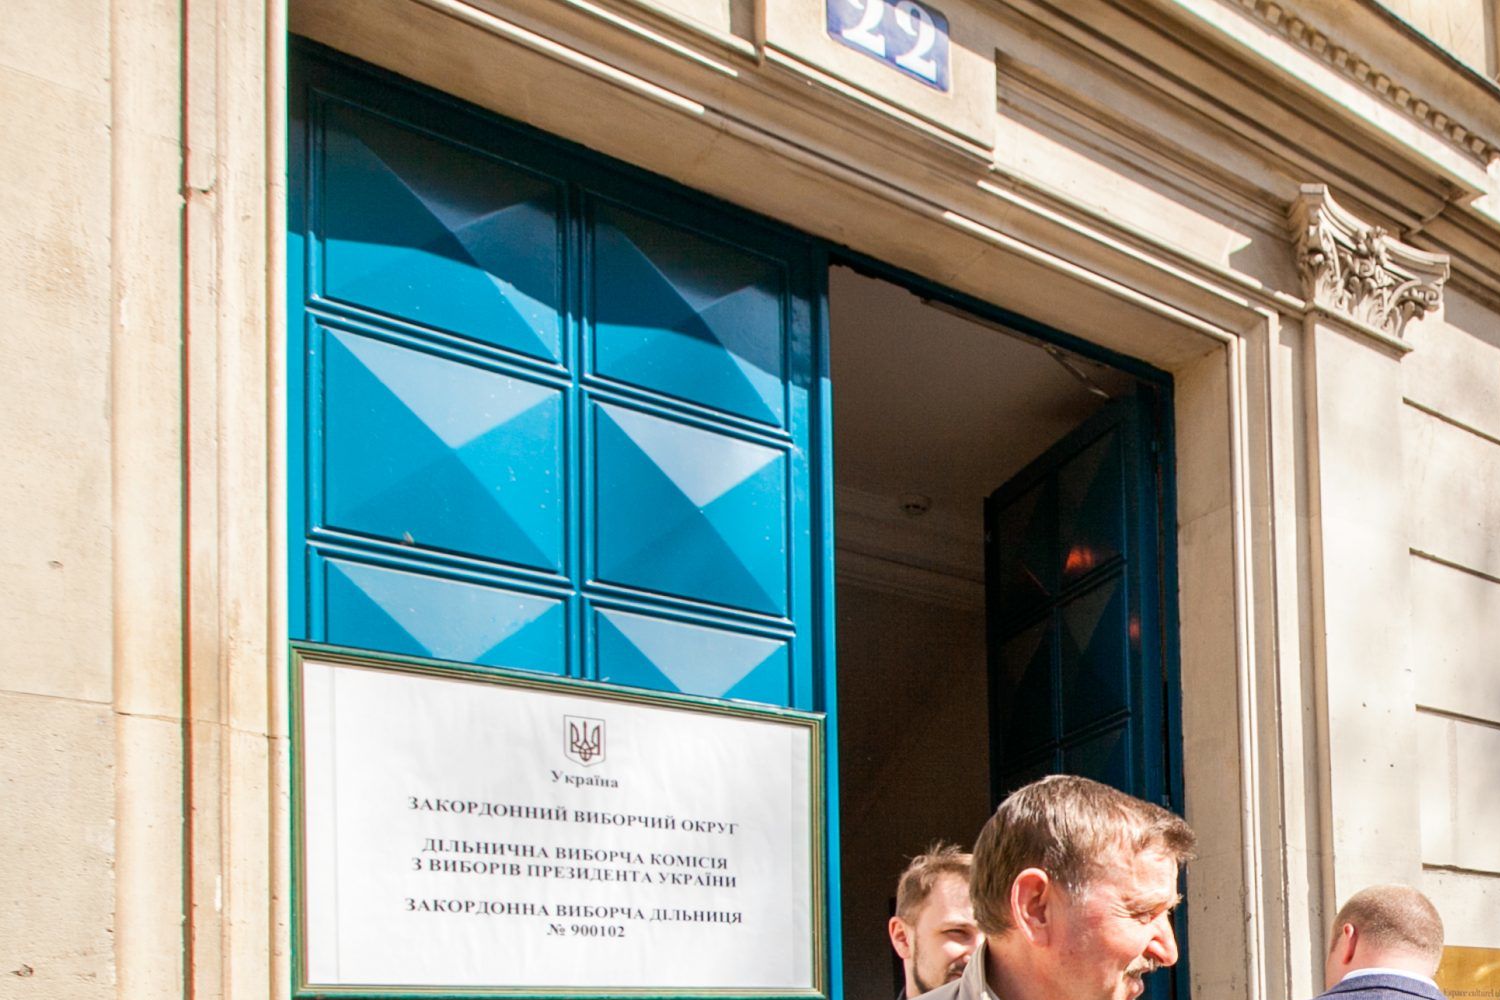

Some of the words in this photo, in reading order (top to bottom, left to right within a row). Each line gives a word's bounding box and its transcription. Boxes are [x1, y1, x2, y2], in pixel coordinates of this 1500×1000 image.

[841, 0, 936, 83] 22
[550, 770, 619, 788] Україна
[407, 796, 568, 822] ЗАКОРДОННИЙ
[574, 809, 676, 830] ВИБОРЧИЙ
[681, 820, 739, 835] ОКРУГ
[422, 838, 549, 859] ДІЛЬНИЧНА
[555, 847, 645, 865] ВИБОРЧА
[650, 853, 728, 869] КОМІСІЯ
[411, 857, 422, 871] З
[429, 859, 521, 876] ВИБОРІВ
[527, 864, 652, 883] ПРЕЗИДЕНТА
[658, 871, 737, 888] УКРАЇНИ
[405, 898, 550, 916] ЗАКОРДОННА
[556, 904, 645, 920] ВИБОРЧА
[650, 908, 742, 924] ДІЛЬНИЦЯ
[571, 924, 625, 937] 900102
